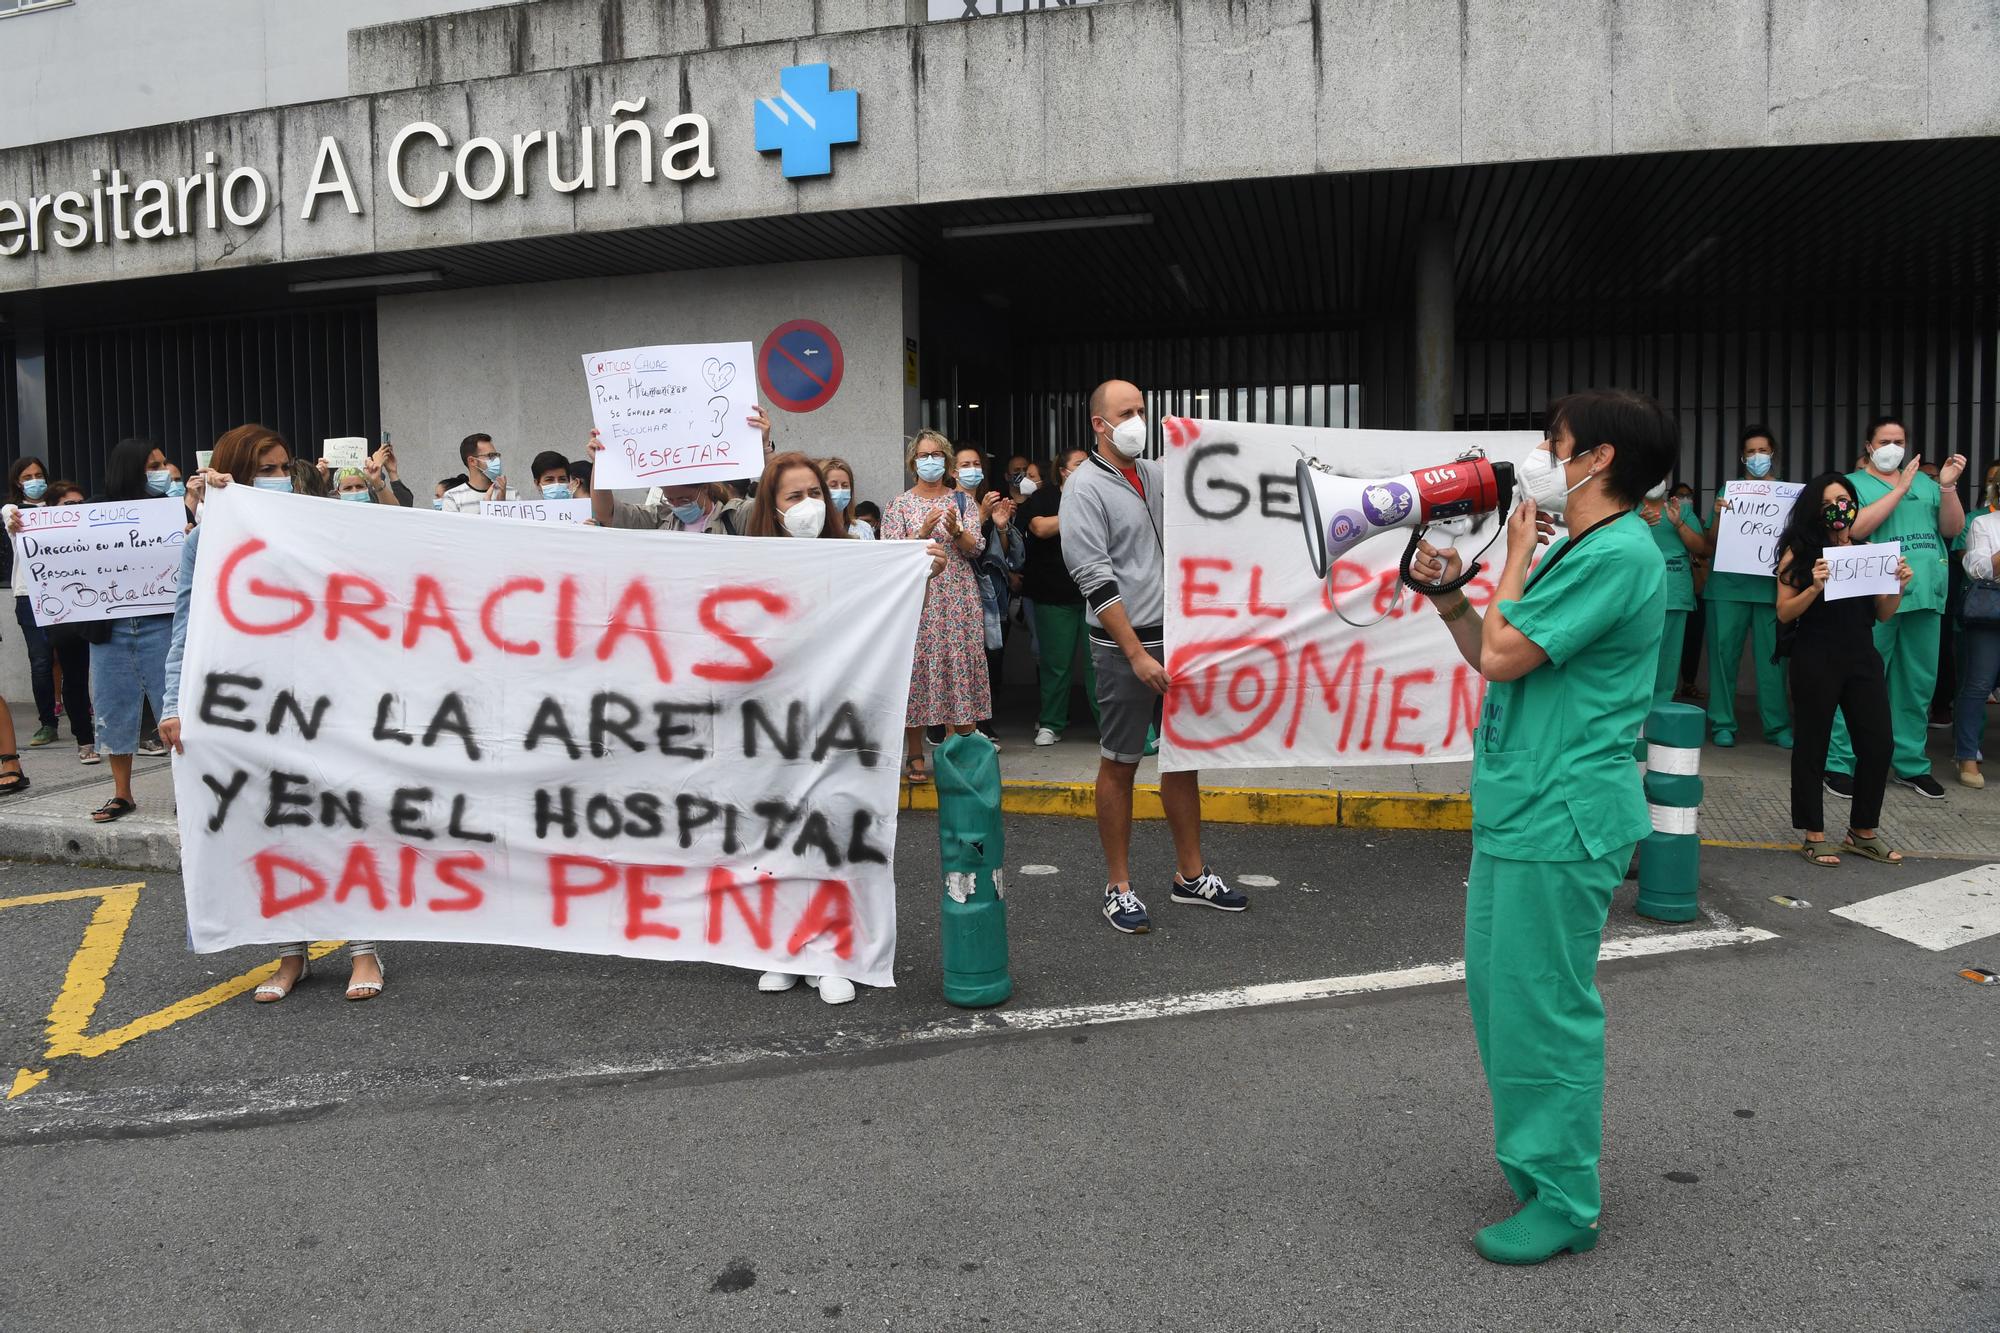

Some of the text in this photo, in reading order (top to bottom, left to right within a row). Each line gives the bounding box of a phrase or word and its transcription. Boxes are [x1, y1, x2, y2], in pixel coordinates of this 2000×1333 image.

[301, 135, 363, 220] A
[387, 96, 716, 208] Coruña
[612, 423, 668, 438] ESCUCHAR
[623, 438, 731, 470] RESPETAR
[1424, 468, 1456, 485] CIG
[559, 512, 572, 520] EN
[1725, 497, 1779, 517] ÁNIMO
[30, 562, 87, 582] PERSONAL
[1179, 556, 1288, 621] EL
[1828, 554, 1900, 582] RESPETO
[216, 538, 788, 683] GRACIAS
[1166, 664, 1265, 718] NO
[199, 670, 880, 767] EN LA ARENA
[202, 769, 890, 868] Y EN EL HOSPITAL
[252, 841, 855, 961] DAIS PENA
